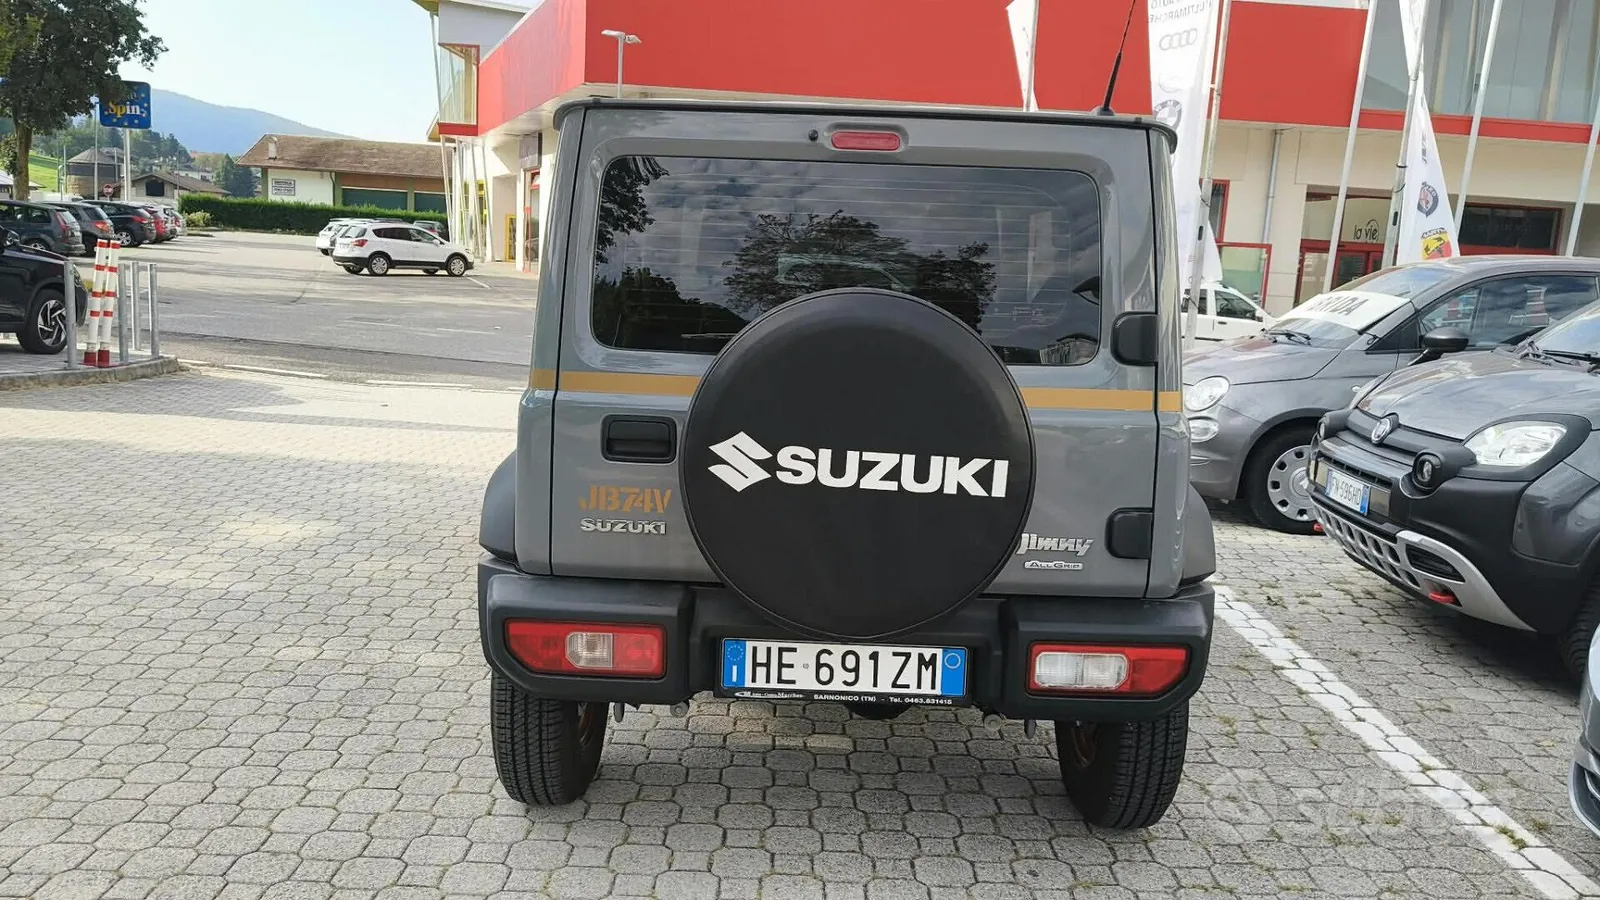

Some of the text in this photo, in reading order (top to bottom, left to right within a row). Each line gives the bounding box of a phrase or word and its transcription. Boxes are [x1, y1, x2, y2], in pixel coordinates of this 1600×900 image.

[108, 101, 141, 117] Spin
[776, 445, 1009, 498] SUZUKI
[579, 484, 672, 514] JB74V
[580, 517, 666, 535] SUZUKI
[1016, 533, 1094, 556] Jimny
[751, 646, 938, 691] HE 691ZM
[813, 693, 860, 701] SARNONICO
[861, 695, 877, 703] (TN)
